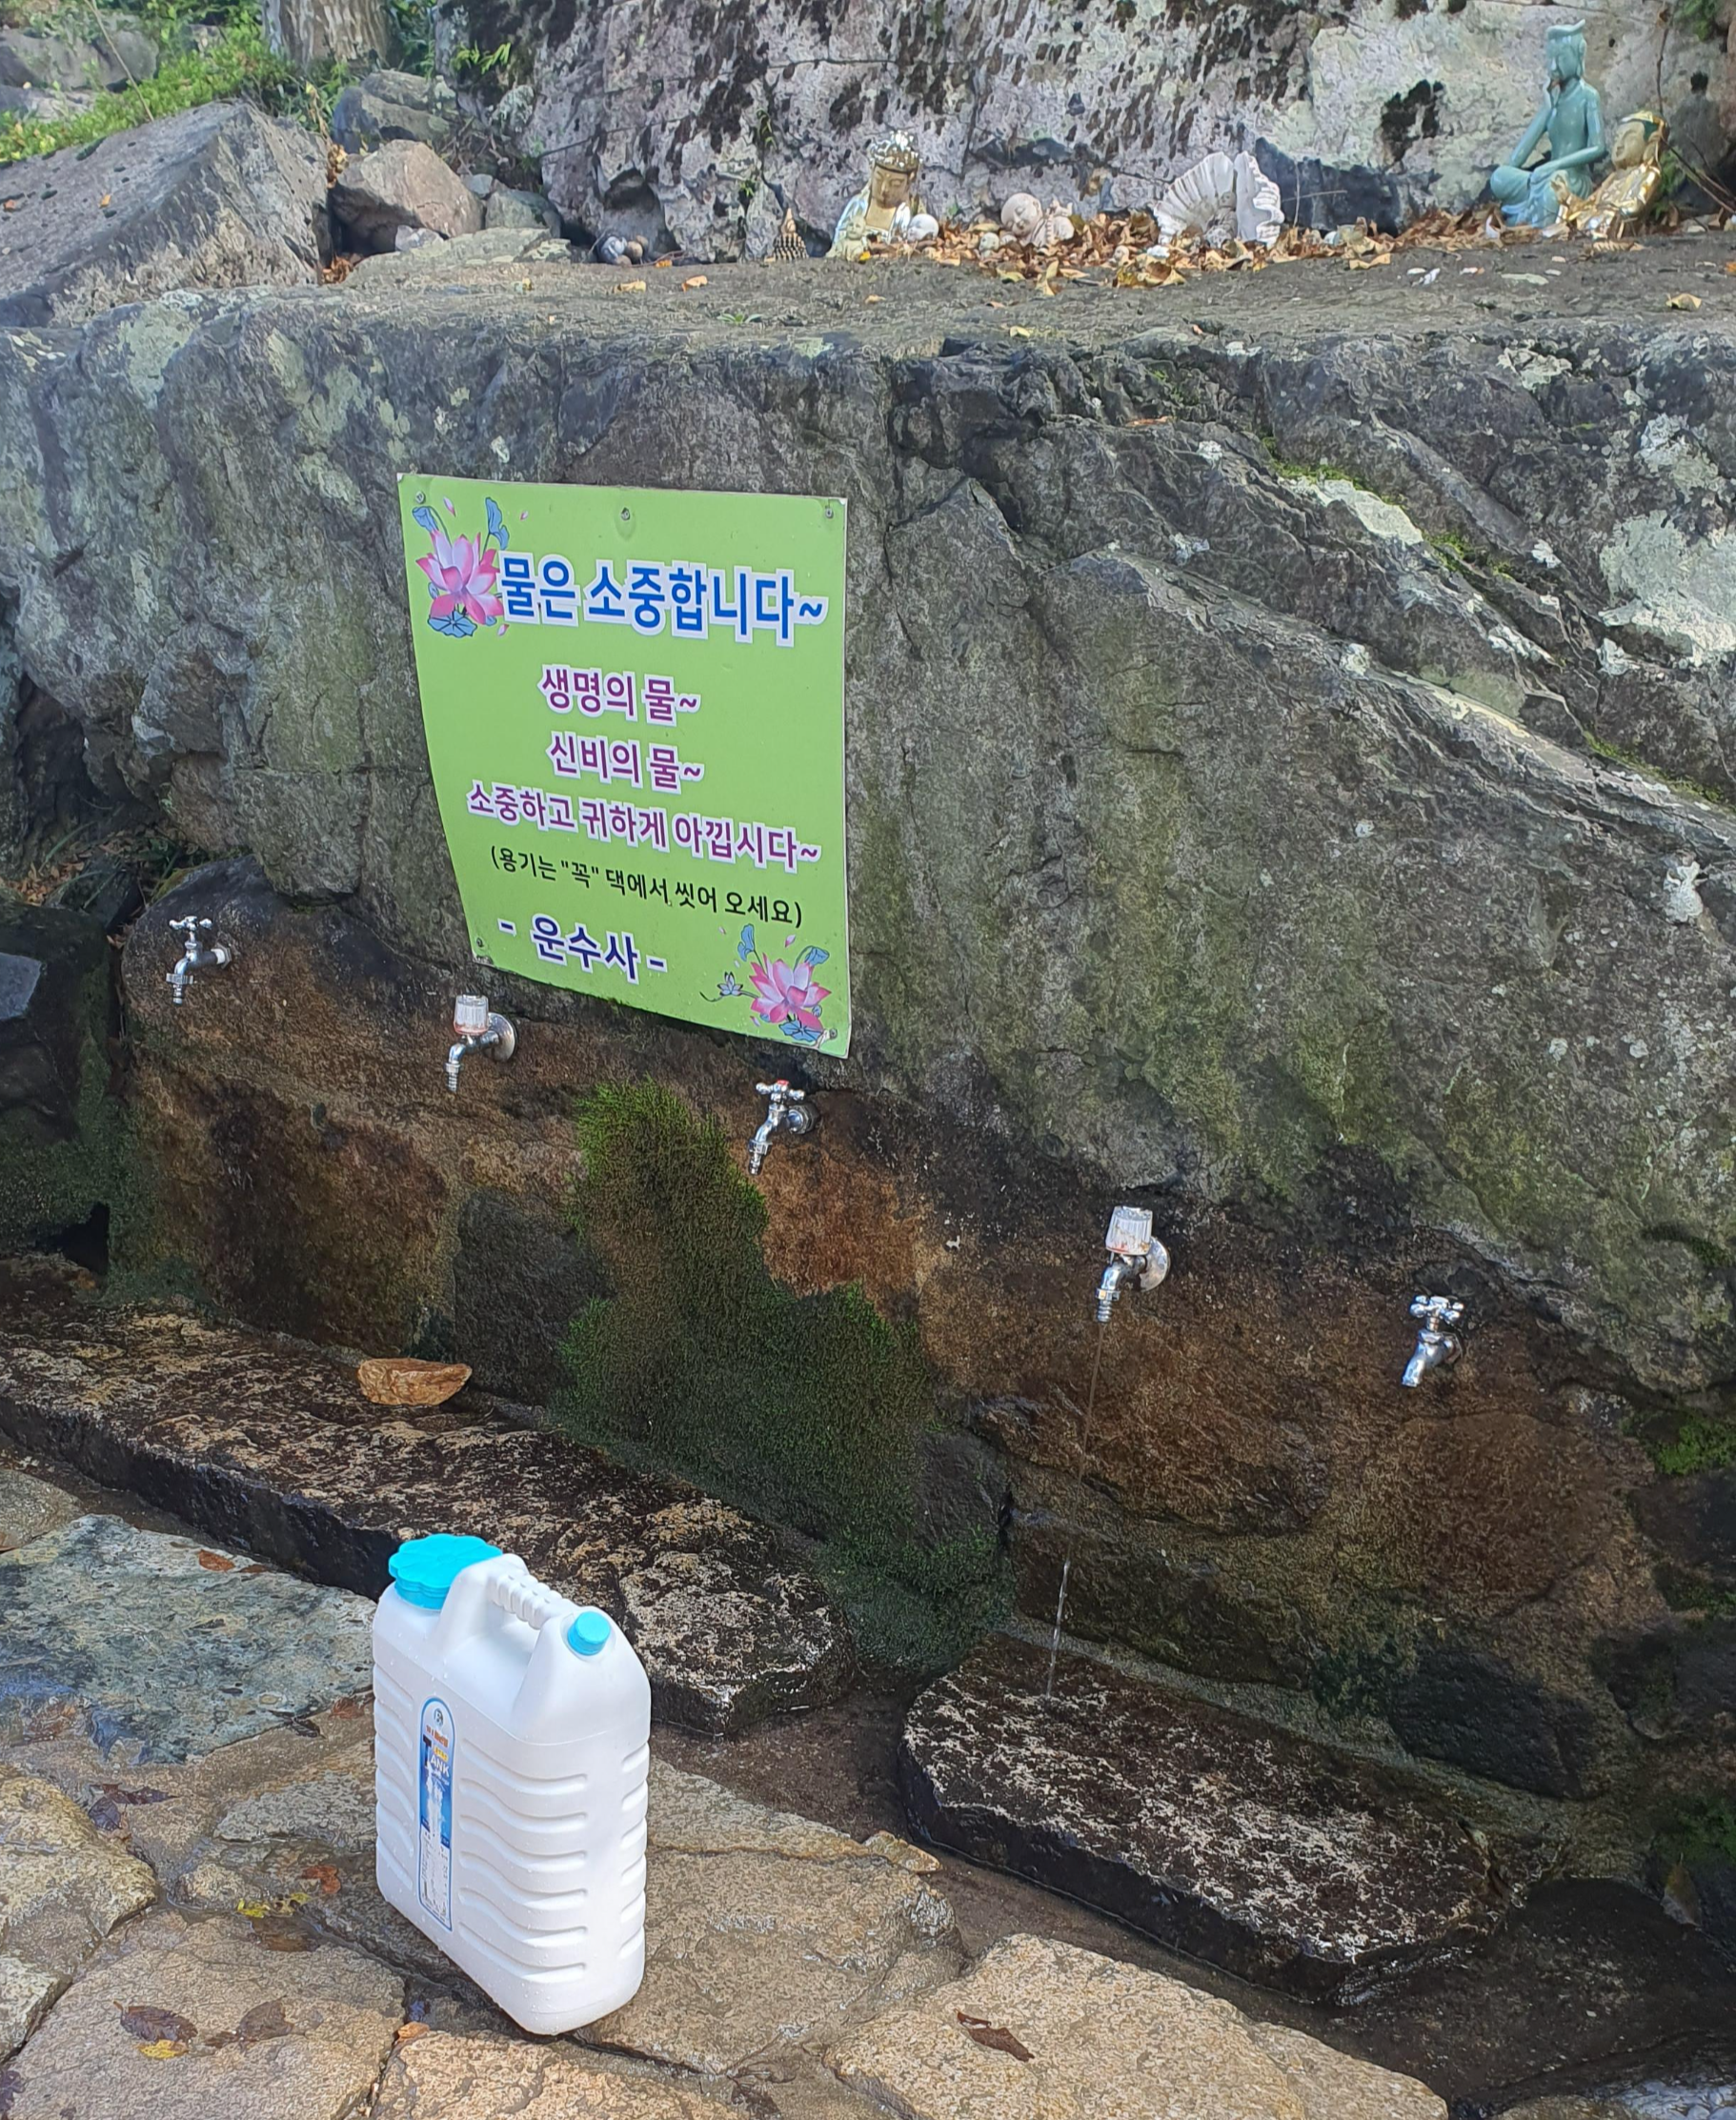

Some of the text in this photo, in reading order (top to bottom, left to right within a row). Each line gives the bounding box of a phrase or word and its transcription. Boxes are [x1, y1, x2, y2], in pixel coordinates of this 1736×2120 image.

[501, 556, 823, 639] 물은 소중합니다~
[542, 668, 697, 722] 생명의 물~
[550, 735, 700, 790] 신비의 물~
[470, 783, 818, 869] 소중하고 귀하게 아낍시다~
[491, 845, 802, 929] (용기는 "꼭" 댁에서 씻어 오세요)
[532, 916, 638, 980] 운수사
